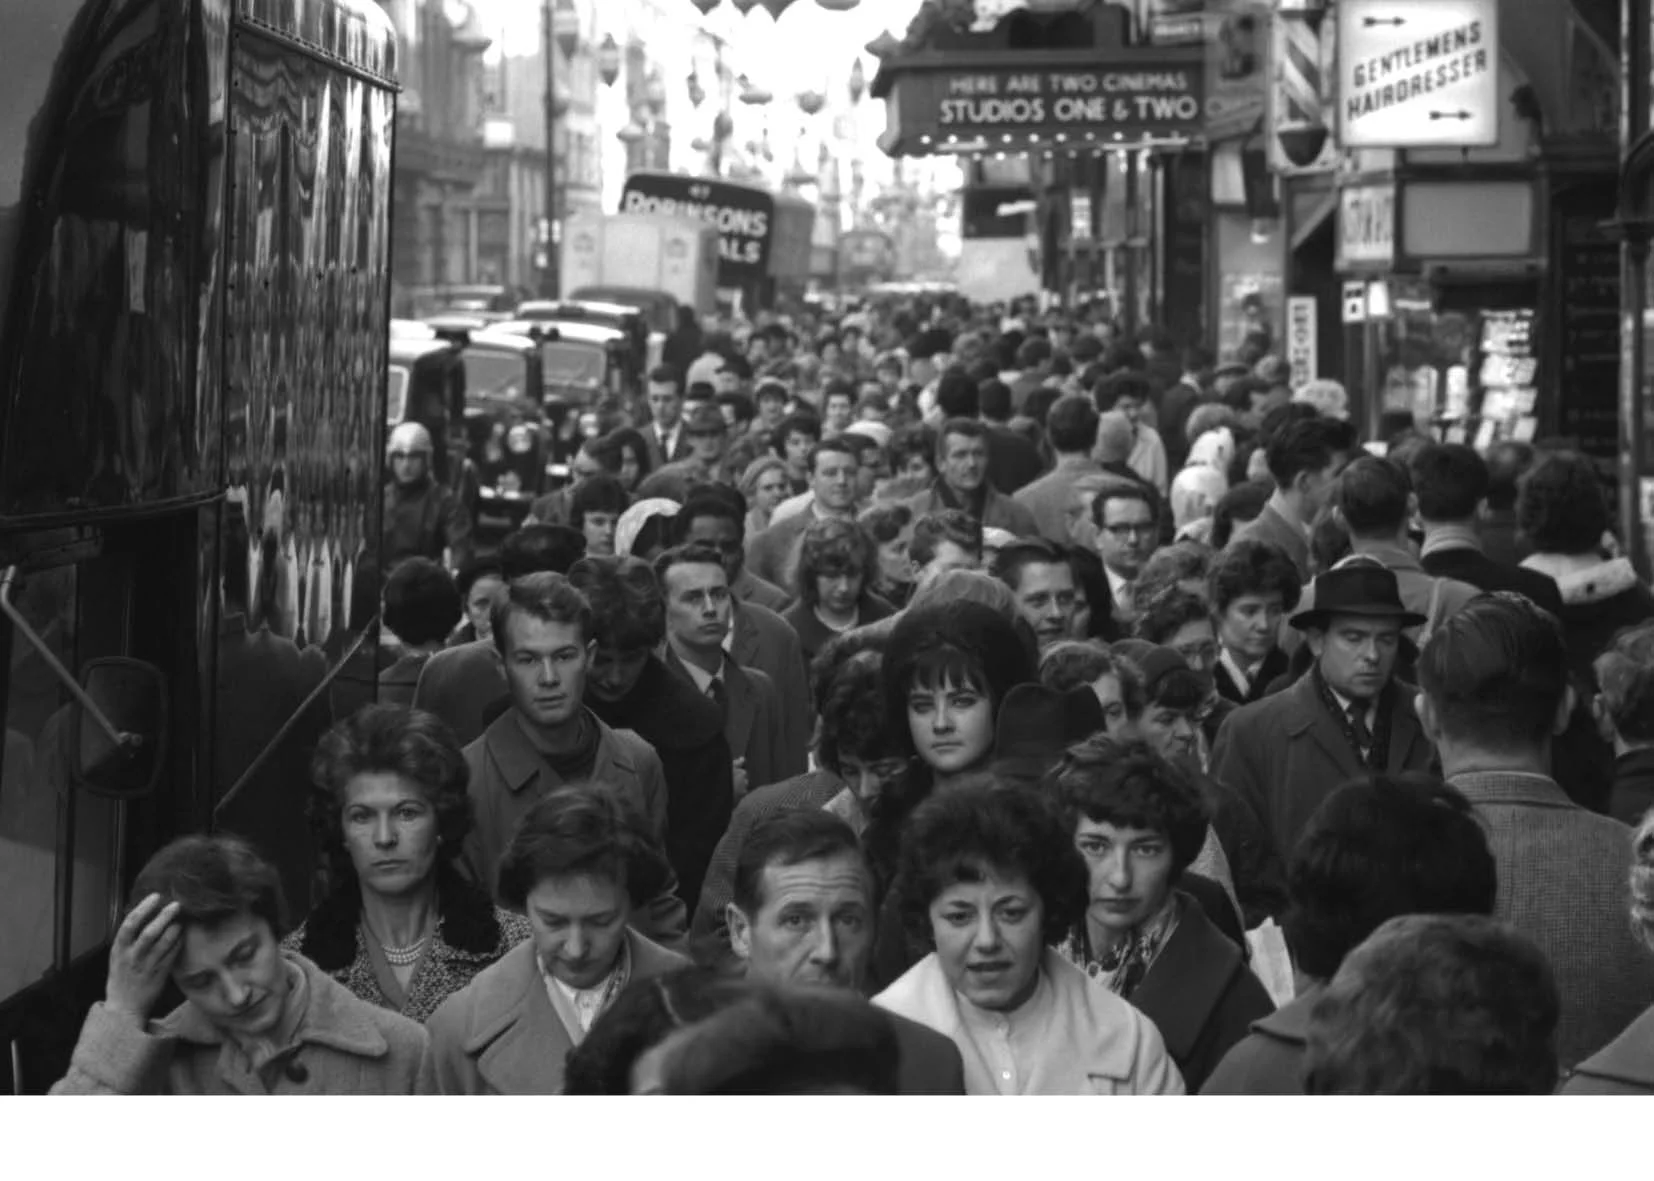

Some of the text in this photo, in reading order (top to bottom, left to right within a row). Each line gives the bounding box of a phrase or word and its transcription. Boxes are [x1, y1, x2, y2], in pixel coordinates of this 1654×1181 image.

[1353, 20, 1481, 88] GENTLEMENS
[950, 71, 1188, 95] HERE ARE TWO CINEMAS
[1347, 48, 1487, 122] HAIRDRESSER
[940, 95, 1198, 123] STUDIOS ONE & TWO
